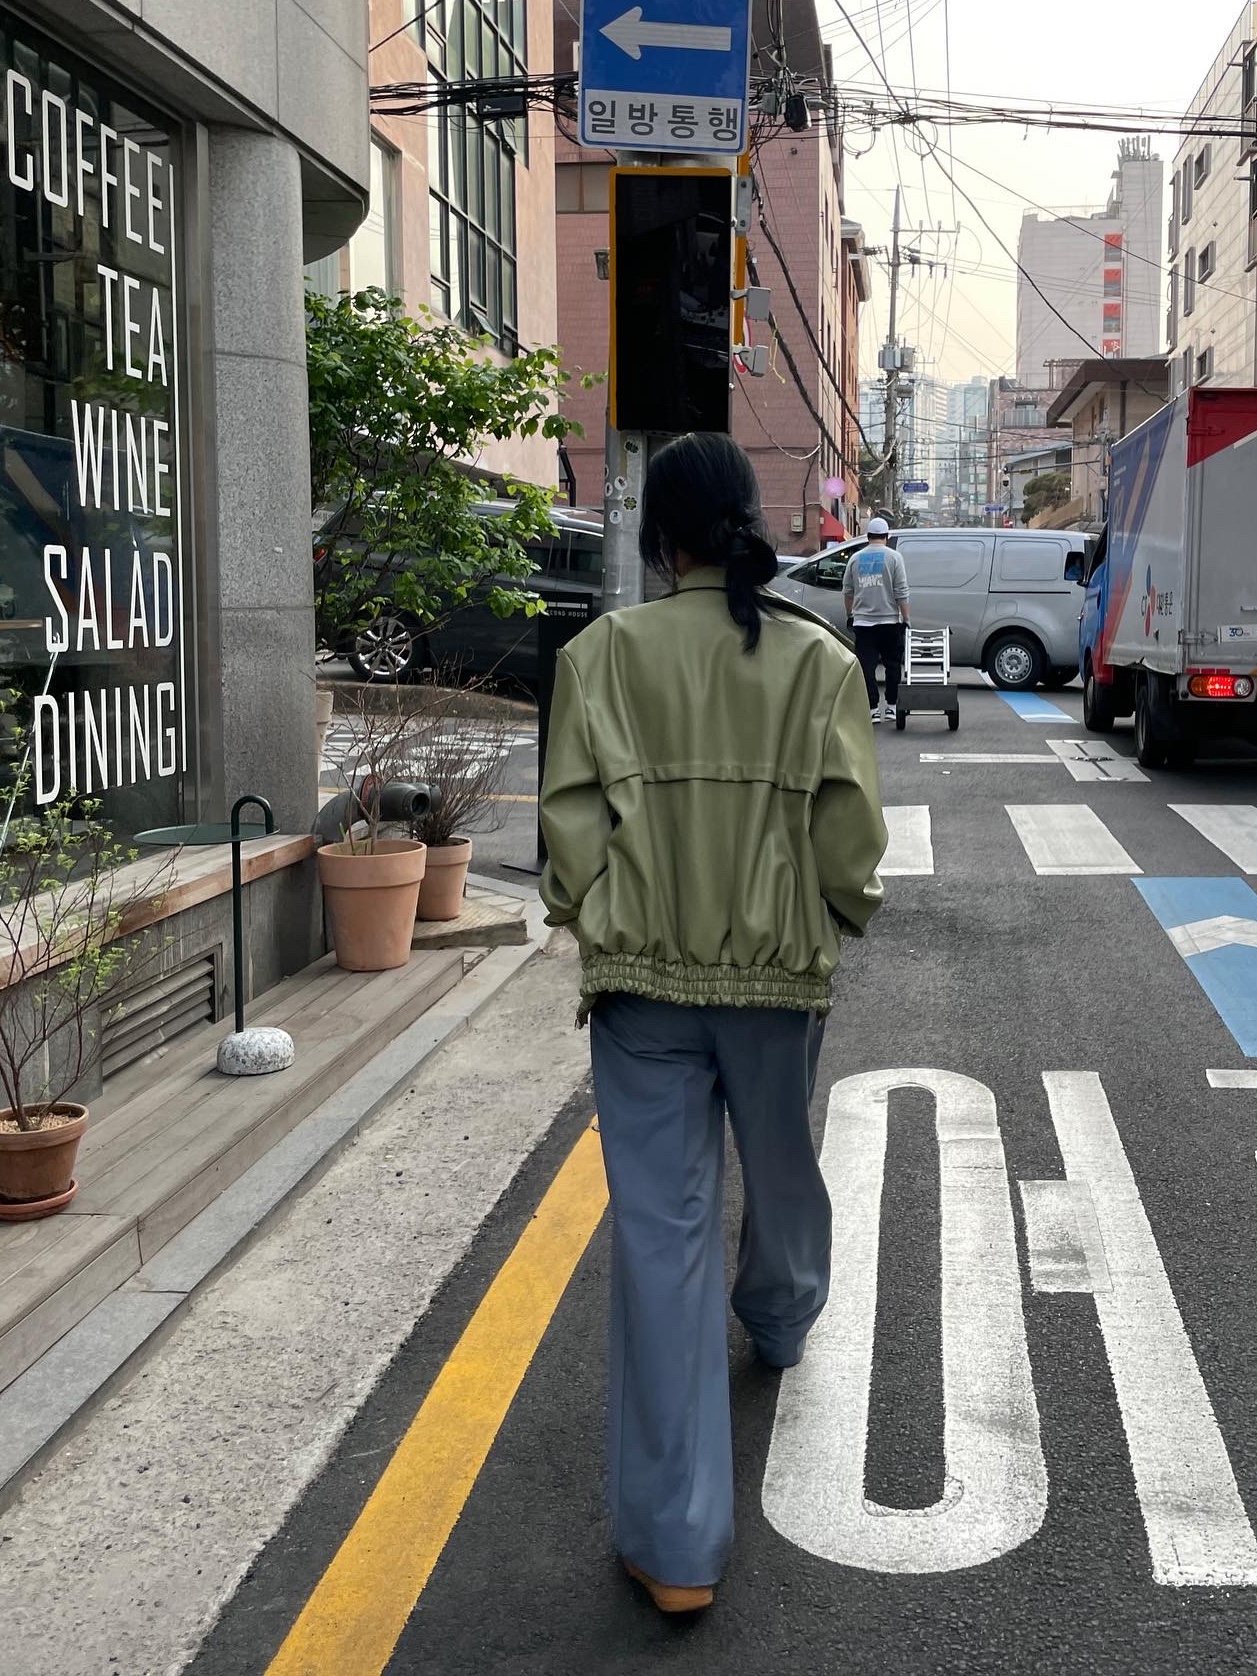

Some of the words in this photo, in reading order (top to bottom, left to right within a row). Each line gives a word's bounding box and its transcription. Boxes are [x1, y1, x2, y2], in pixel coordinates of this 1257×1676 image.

[7, 68, 165, 255] COFFEE
[588, 100, 738, 142] 일방통행
[97, 263, 168, 387] TEA
[71, 399, 171, 517] WINE
[43, 544, 174, 655] SALAD
[34, 681, 177, 806] DINING
